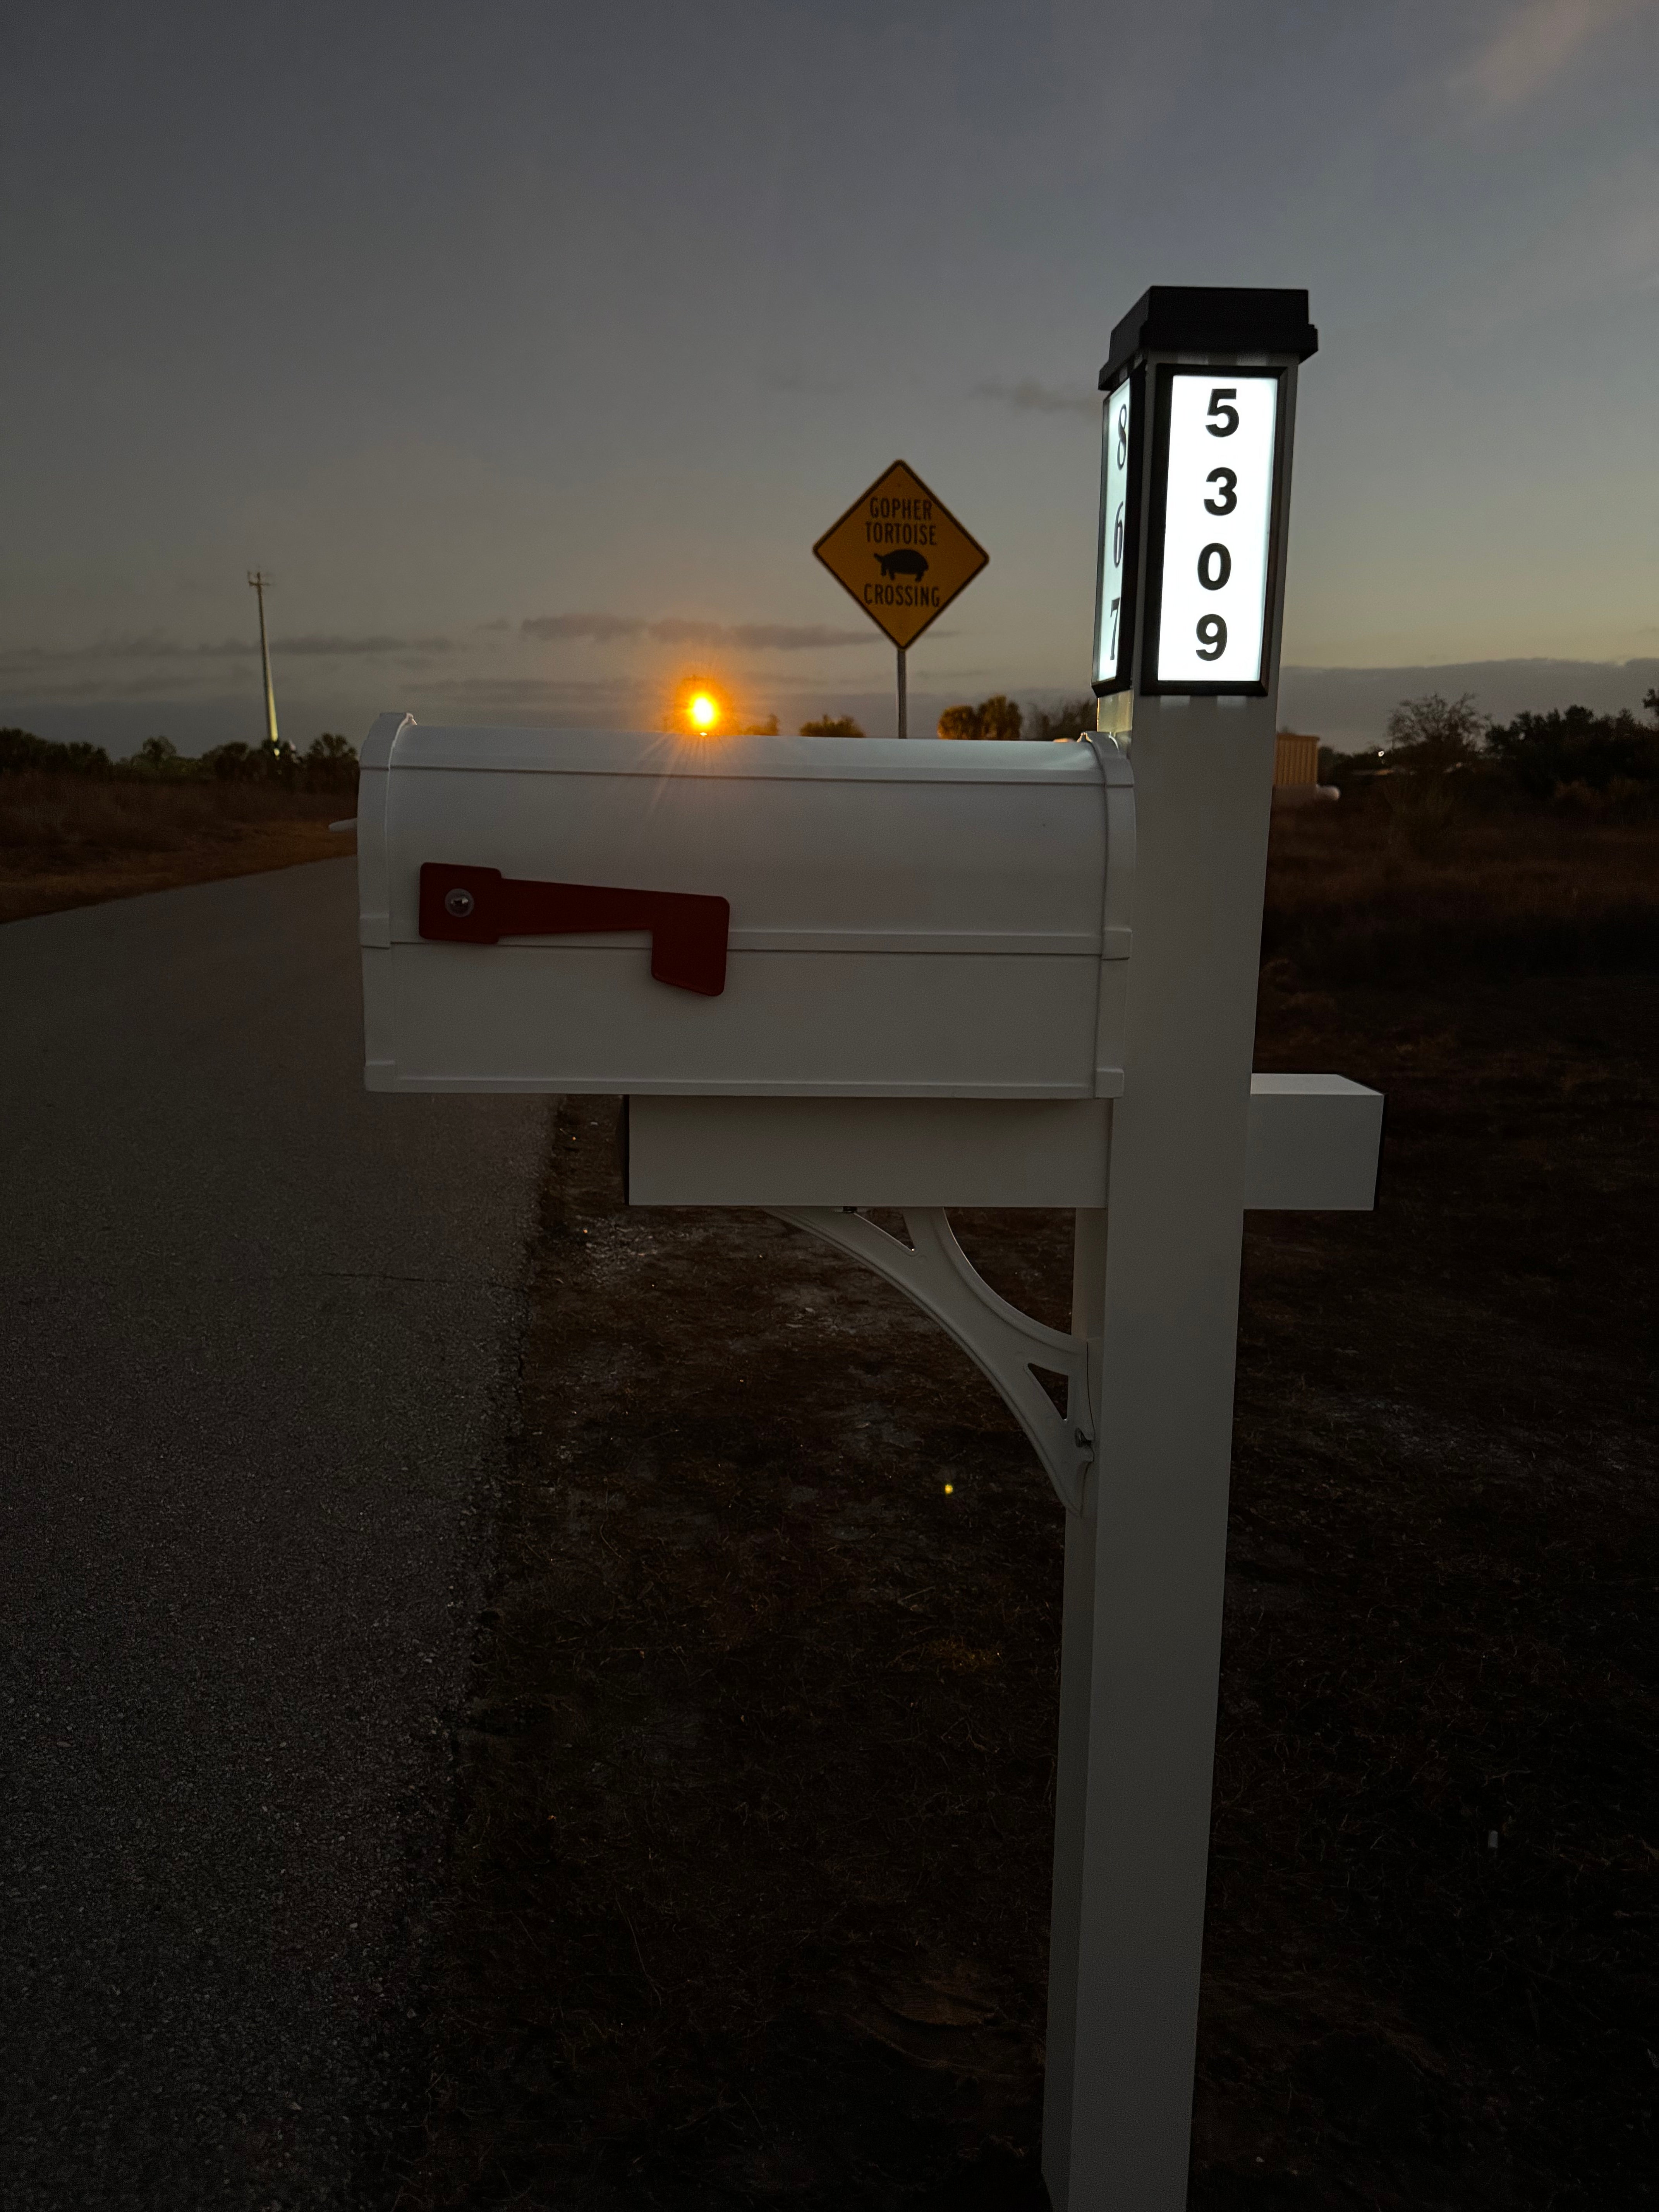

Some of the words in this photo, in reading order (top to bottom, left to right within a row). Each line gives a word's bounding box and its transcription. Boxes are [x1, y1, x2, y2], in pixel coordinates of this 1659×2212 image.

[870, 497, 933, 520] GOPHER
[865, 522, 936, 545] TORTOISE
[1196, 388, 1240, 661] 5309
[864, 584, 940, 607] CROSSING
